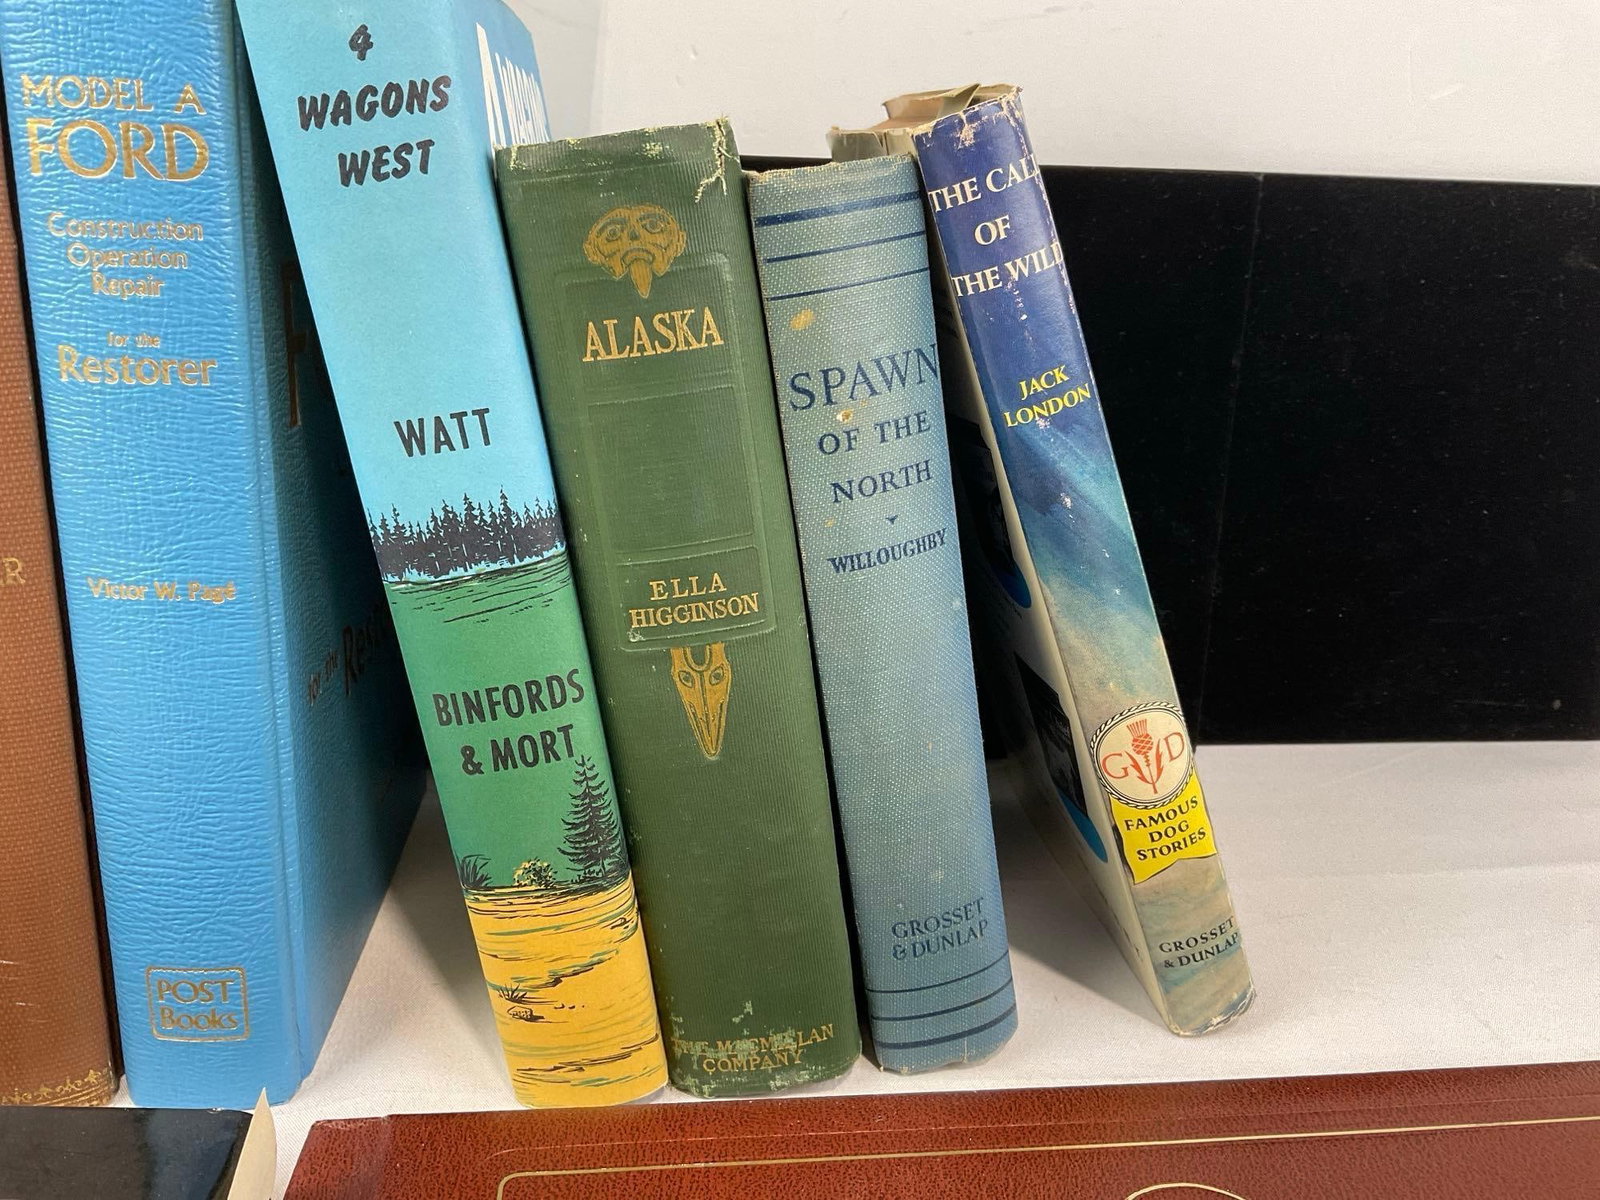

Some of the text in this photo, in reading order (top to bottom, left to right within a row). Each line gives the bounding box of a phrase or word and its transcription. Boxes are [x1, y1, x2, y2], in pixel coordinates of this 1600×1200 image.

[349, 23, 374, 62] 4
[20, 73, 207, 115] MODEL A
[297, 74, 452, 132] WAGONS
[26, 117, 210, 182] FORD
[337, 138, 436, 188] WEST
[928, 176, 982, 213] THE
[47, 211, 205, 242] Construction
[974, 214, 1011, 246] OF
[66, 241, 189, 271] Operation
[91, 271, 165, 300] Repair
[951, 266, 1003, 297] THE
[107, 331, 162, 349] for the
[582, 305, 726, 363] ALASKA
[57, 343, 219, 387] Restorer
[788, 342, 940, 412] SPAWN
[1019, 364, 1070, 401] JACK
[1003, 382, 1092, 428] LONDON
[393, 407, 492, 458] WATT
[816, 410, 931, 456] OF THE
[829, 458, 933, 504] NORTH
[826, 527, 948, 574] WILLOUGHBY
[86, 576, 148, 601] Victor
[153, 580, 182, 602] W.
[648, 571, 728, 602] ELLA
[628, 592, 760, 629] HIGGINSON
[432, 668, 586, 727] BINFORDS
[460, 723, 575, 776] & MORT
[1124, 794, 1200, 832] FAMOUS
[1148, 820, 1191, 844] DOG
[1136, 827, 1208, 863] STORIES
[891, 896, 985, 939] GROSSET
[1158, 916, 1236, 955] GROSSET
[892, 918, 989, 961] & DUNLAP
[1163, 931, 1240, 969] & DUNLAP
[156, 978, 236, 1004] POST
[159, 1006, 240, 1031] Books
[702, 1048, 804, 1073] COMPANY
